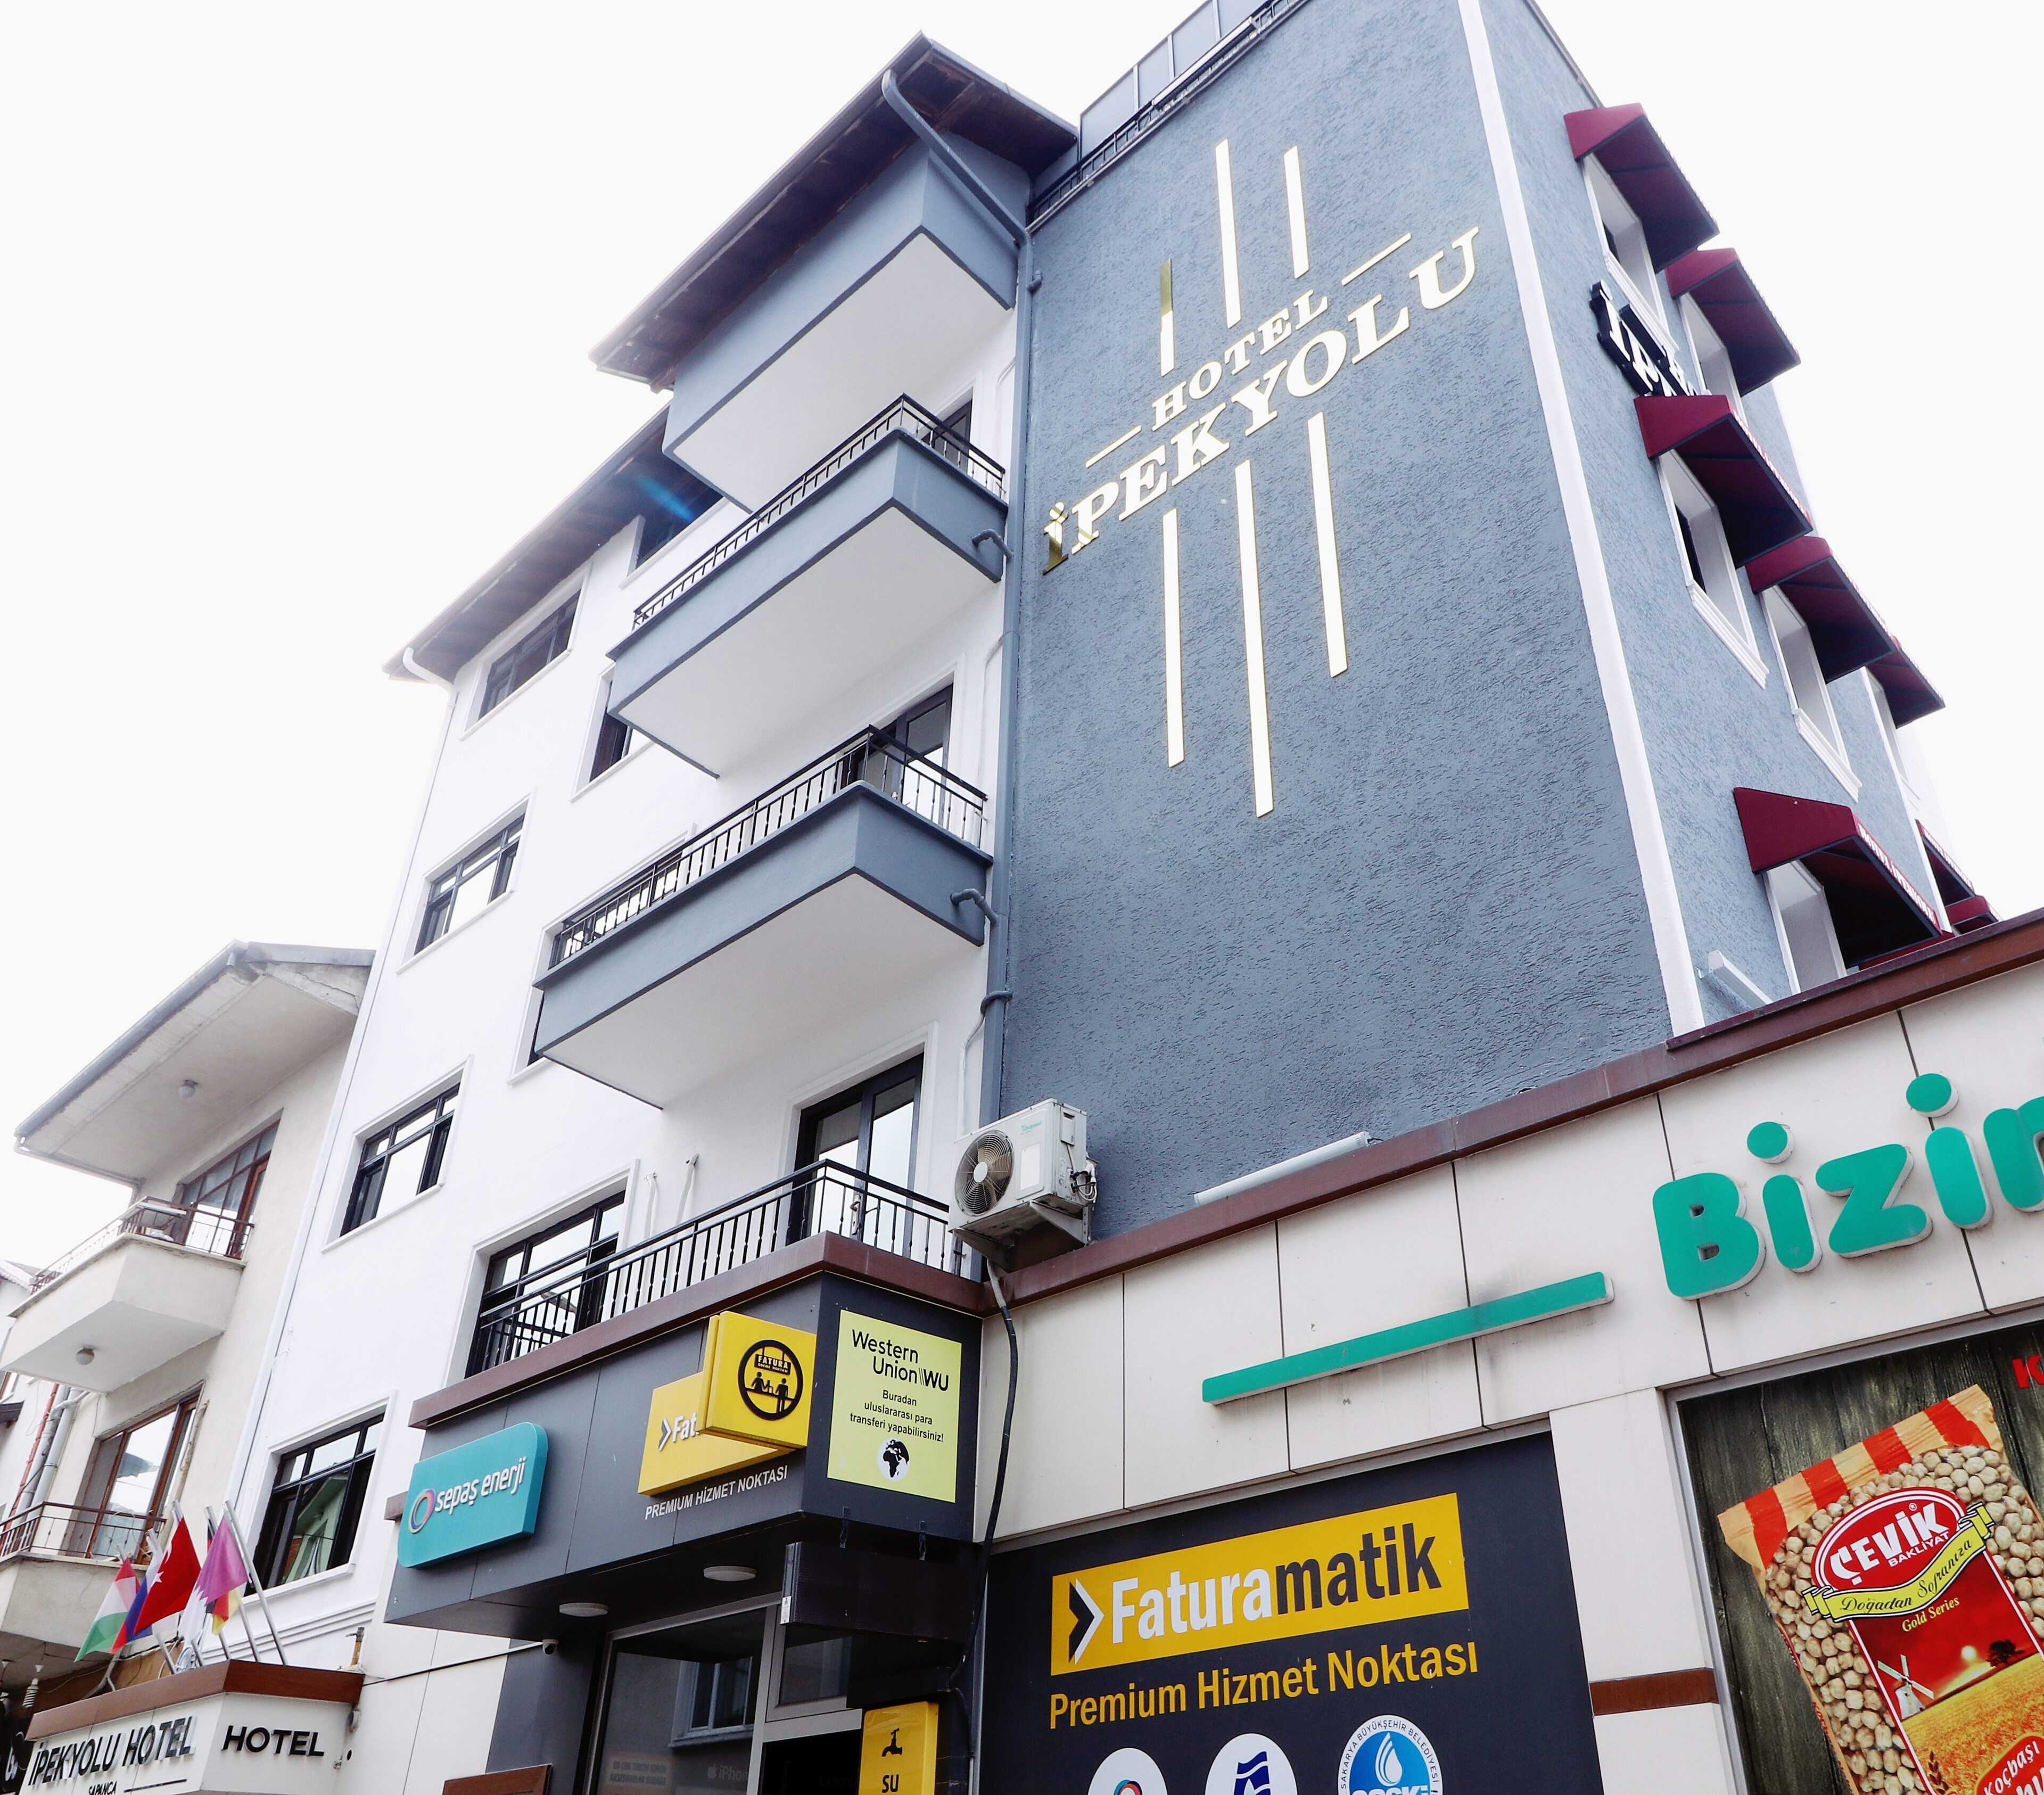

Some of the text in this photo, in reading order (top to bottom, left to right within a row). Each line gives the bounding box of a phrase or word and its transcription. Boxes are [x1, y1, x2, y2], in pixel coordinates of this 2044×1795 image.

[1151, 289, 1329, 432] HOTEL
[1042, 226, 1479, 575] İPEKYOLU
[758, 1355, 788, 1369] FATURA
[852, 1329, 918, 1363] Western
[873, 1356, 917, 1384] Union
[864, 1401, 932, 1425] uluslararası para
[883, 1390, 917, 1406] Buradan
[672, 1412, 700, 1443] Fat
[850, 1413, 944, 1442] transferi yapabilirsiniz!
[434, 1456, 527, 1514] sepaş enerji
[645, 1464, 788, 1520] PREMIUM HİZMET NOKTASI
[1830, 1502, 1949, 1585] ÇEVİK
[1888, 1531, 1950, 1567] BAKLİYAT
[1111, 1523, 1443, 1644] Faturamatik
[1840, 1539, 1972, 1614] Doğadan Sofranıza
[1902, 1597, 1960, 1632] Gold Series
[1049, 1641, 1479, 1730] Premium Hizmet Noktası
[28, 1732, 122, 1786] İPEKYOLU
[122, 1715, 195, 1767] HOTEL
[221, 1725, 324, 1757] HOTEL
[1341, 1742, 1358, 1789] SAKARYA
[1357, 1719, 1406, 1741] BÜYÜKŞEHİR
[881, 1774, 900, 1793] SU
[1983, 1741, 2040, 1795] Koçbaşı
